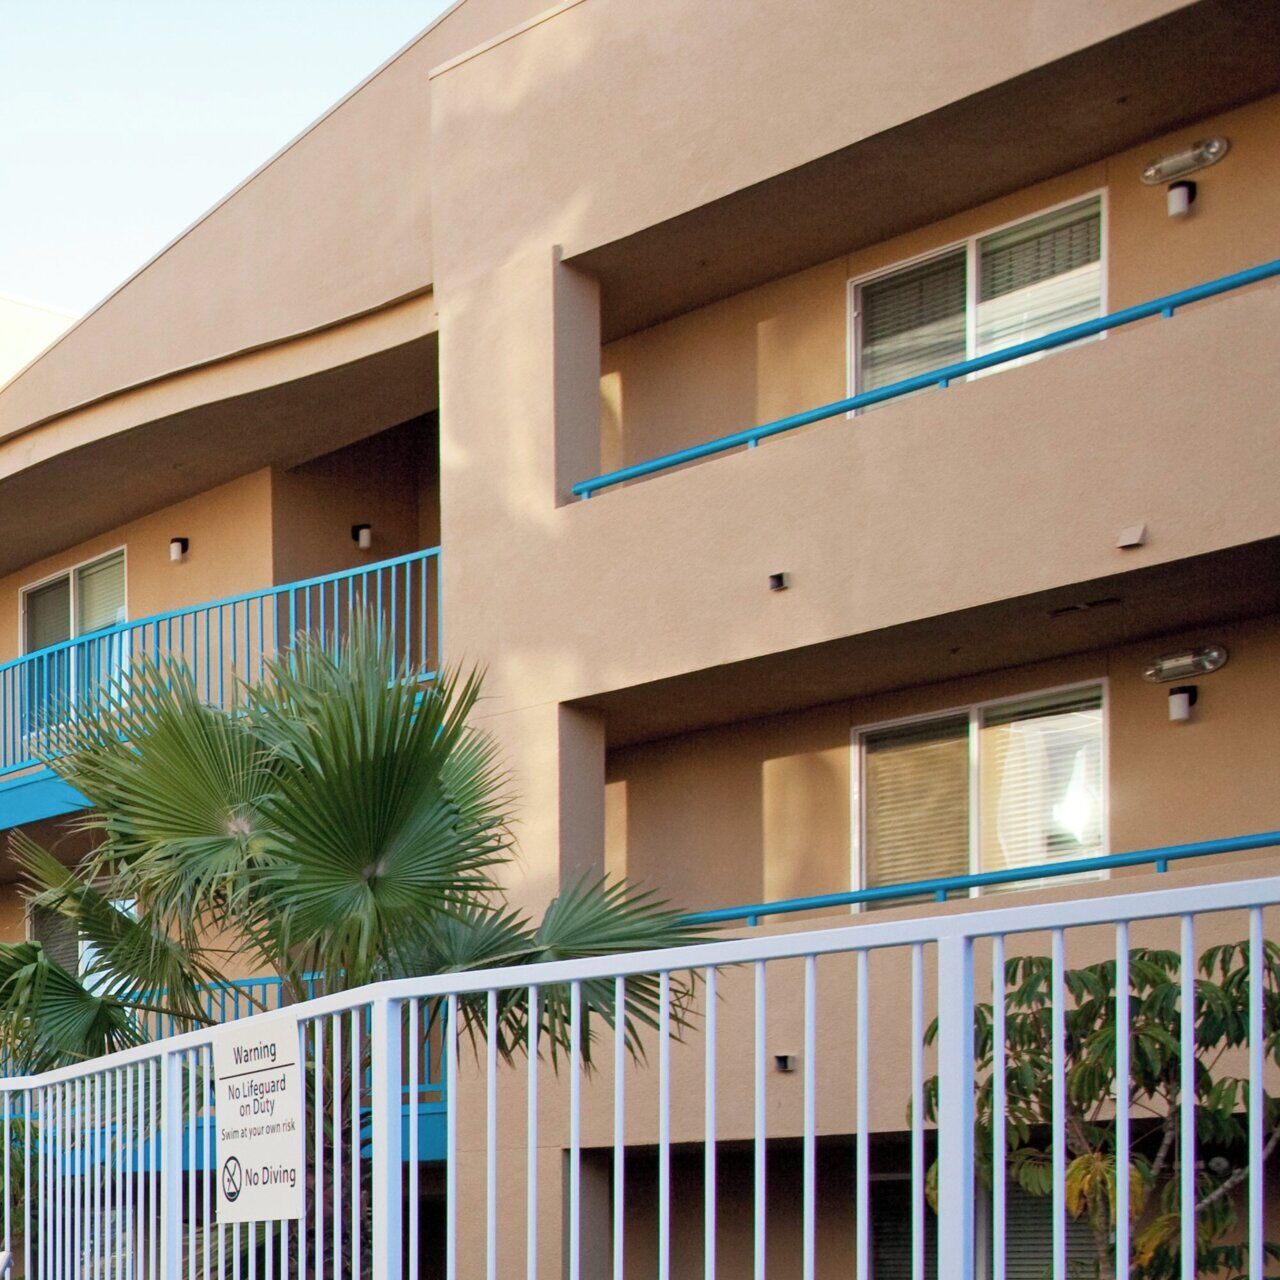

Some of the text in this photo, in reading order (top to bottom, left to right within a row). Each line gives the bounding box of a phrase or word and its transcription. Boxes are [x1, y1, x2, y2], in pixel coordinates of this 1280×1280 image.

[233, 1041, 277, 1065] Warning
[228, 1073, 287, 1101] No Lifeguard
[240, 1097, 276, 1117] on Duty
[221, 1118, 296, 1141] Swim at your own risk
[245, 1165, 297, 1188] No Diving
